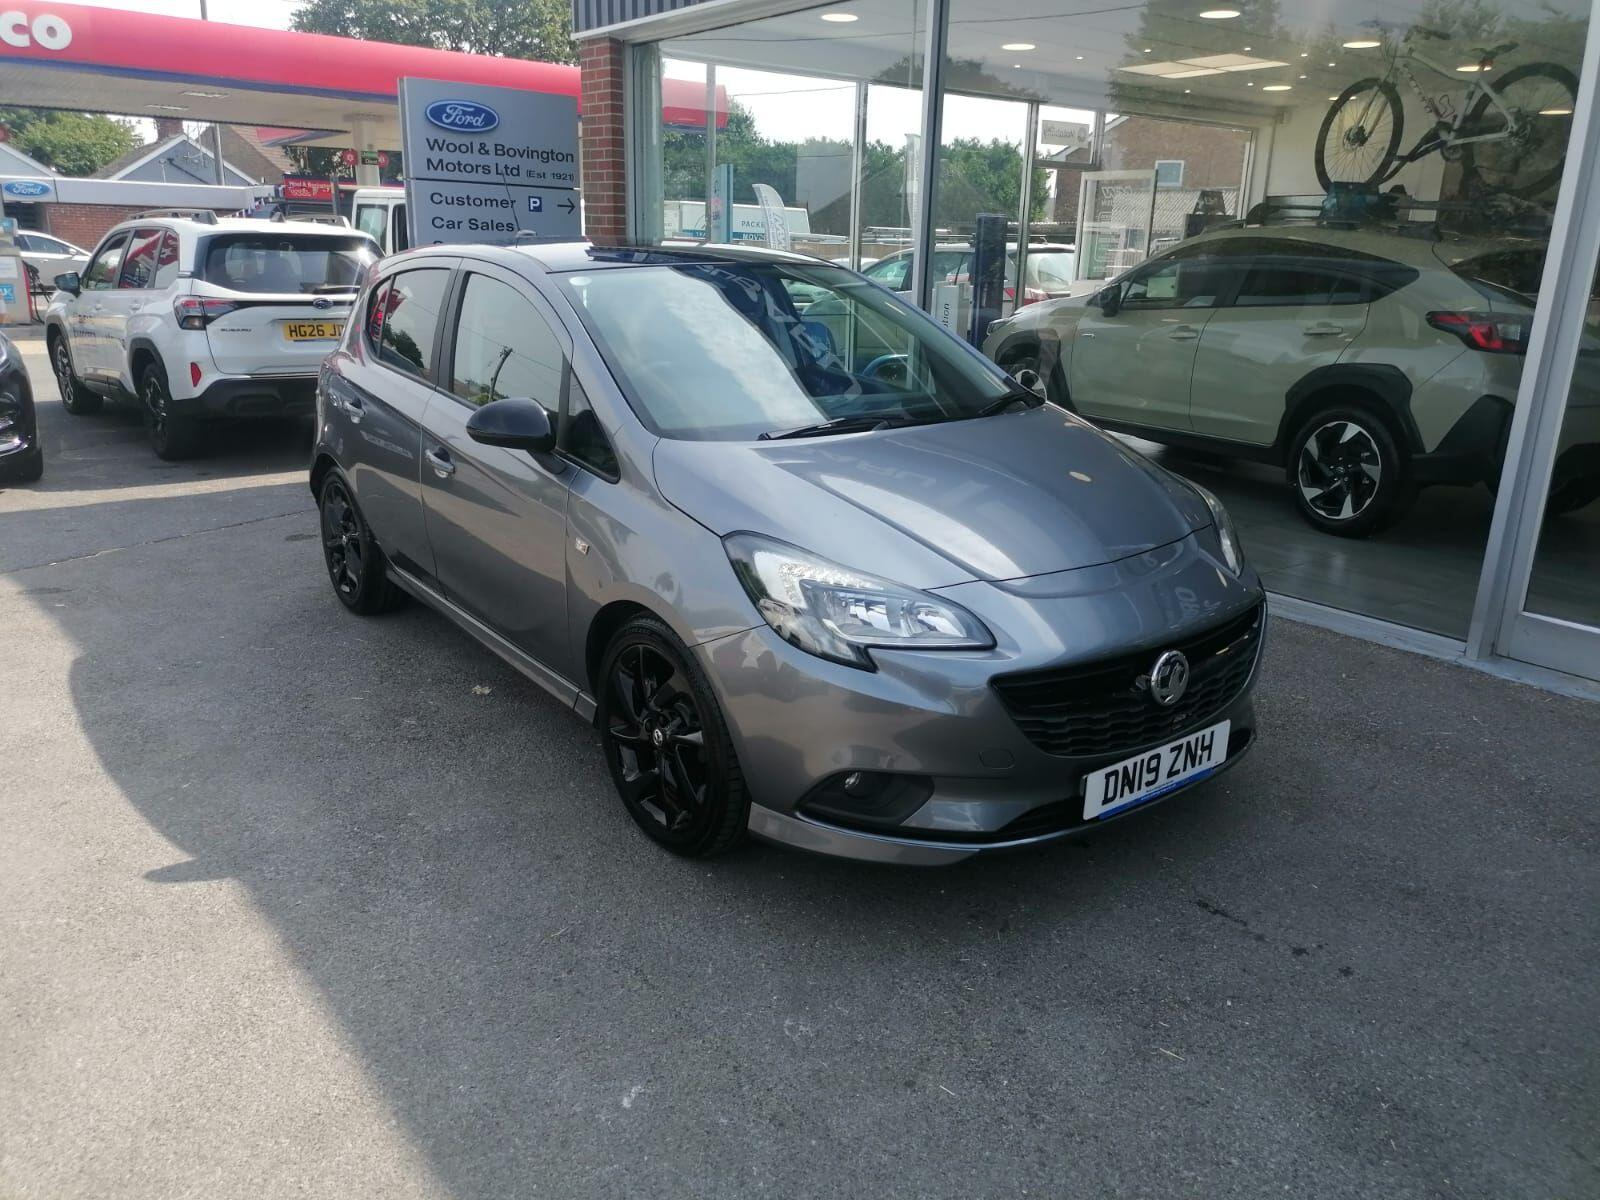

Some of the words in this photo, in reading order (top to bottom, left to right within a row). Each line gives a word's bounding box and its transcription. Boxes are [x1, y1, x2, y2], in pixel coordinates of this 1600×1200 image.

[442, 104, 485, 127] Ford
[426, 138, 474, 154] Wool
[478, 142, 490, 155] &
[494, 143, 574, 163] Bovington
[426, 158, 491, 176] Motors
[495, 162, 520, 177] Ltd
[430, 192, 516, 210] Customer
[530, 197, 541, 211] P
[431, 216, 463, 230] Car
[468, 218, 515, 232] Sales
[289, 324, 325, 338] HG26
[1101, 752, 1162, 806] DN19
[1166, 730, 1215, 779] ZNH
